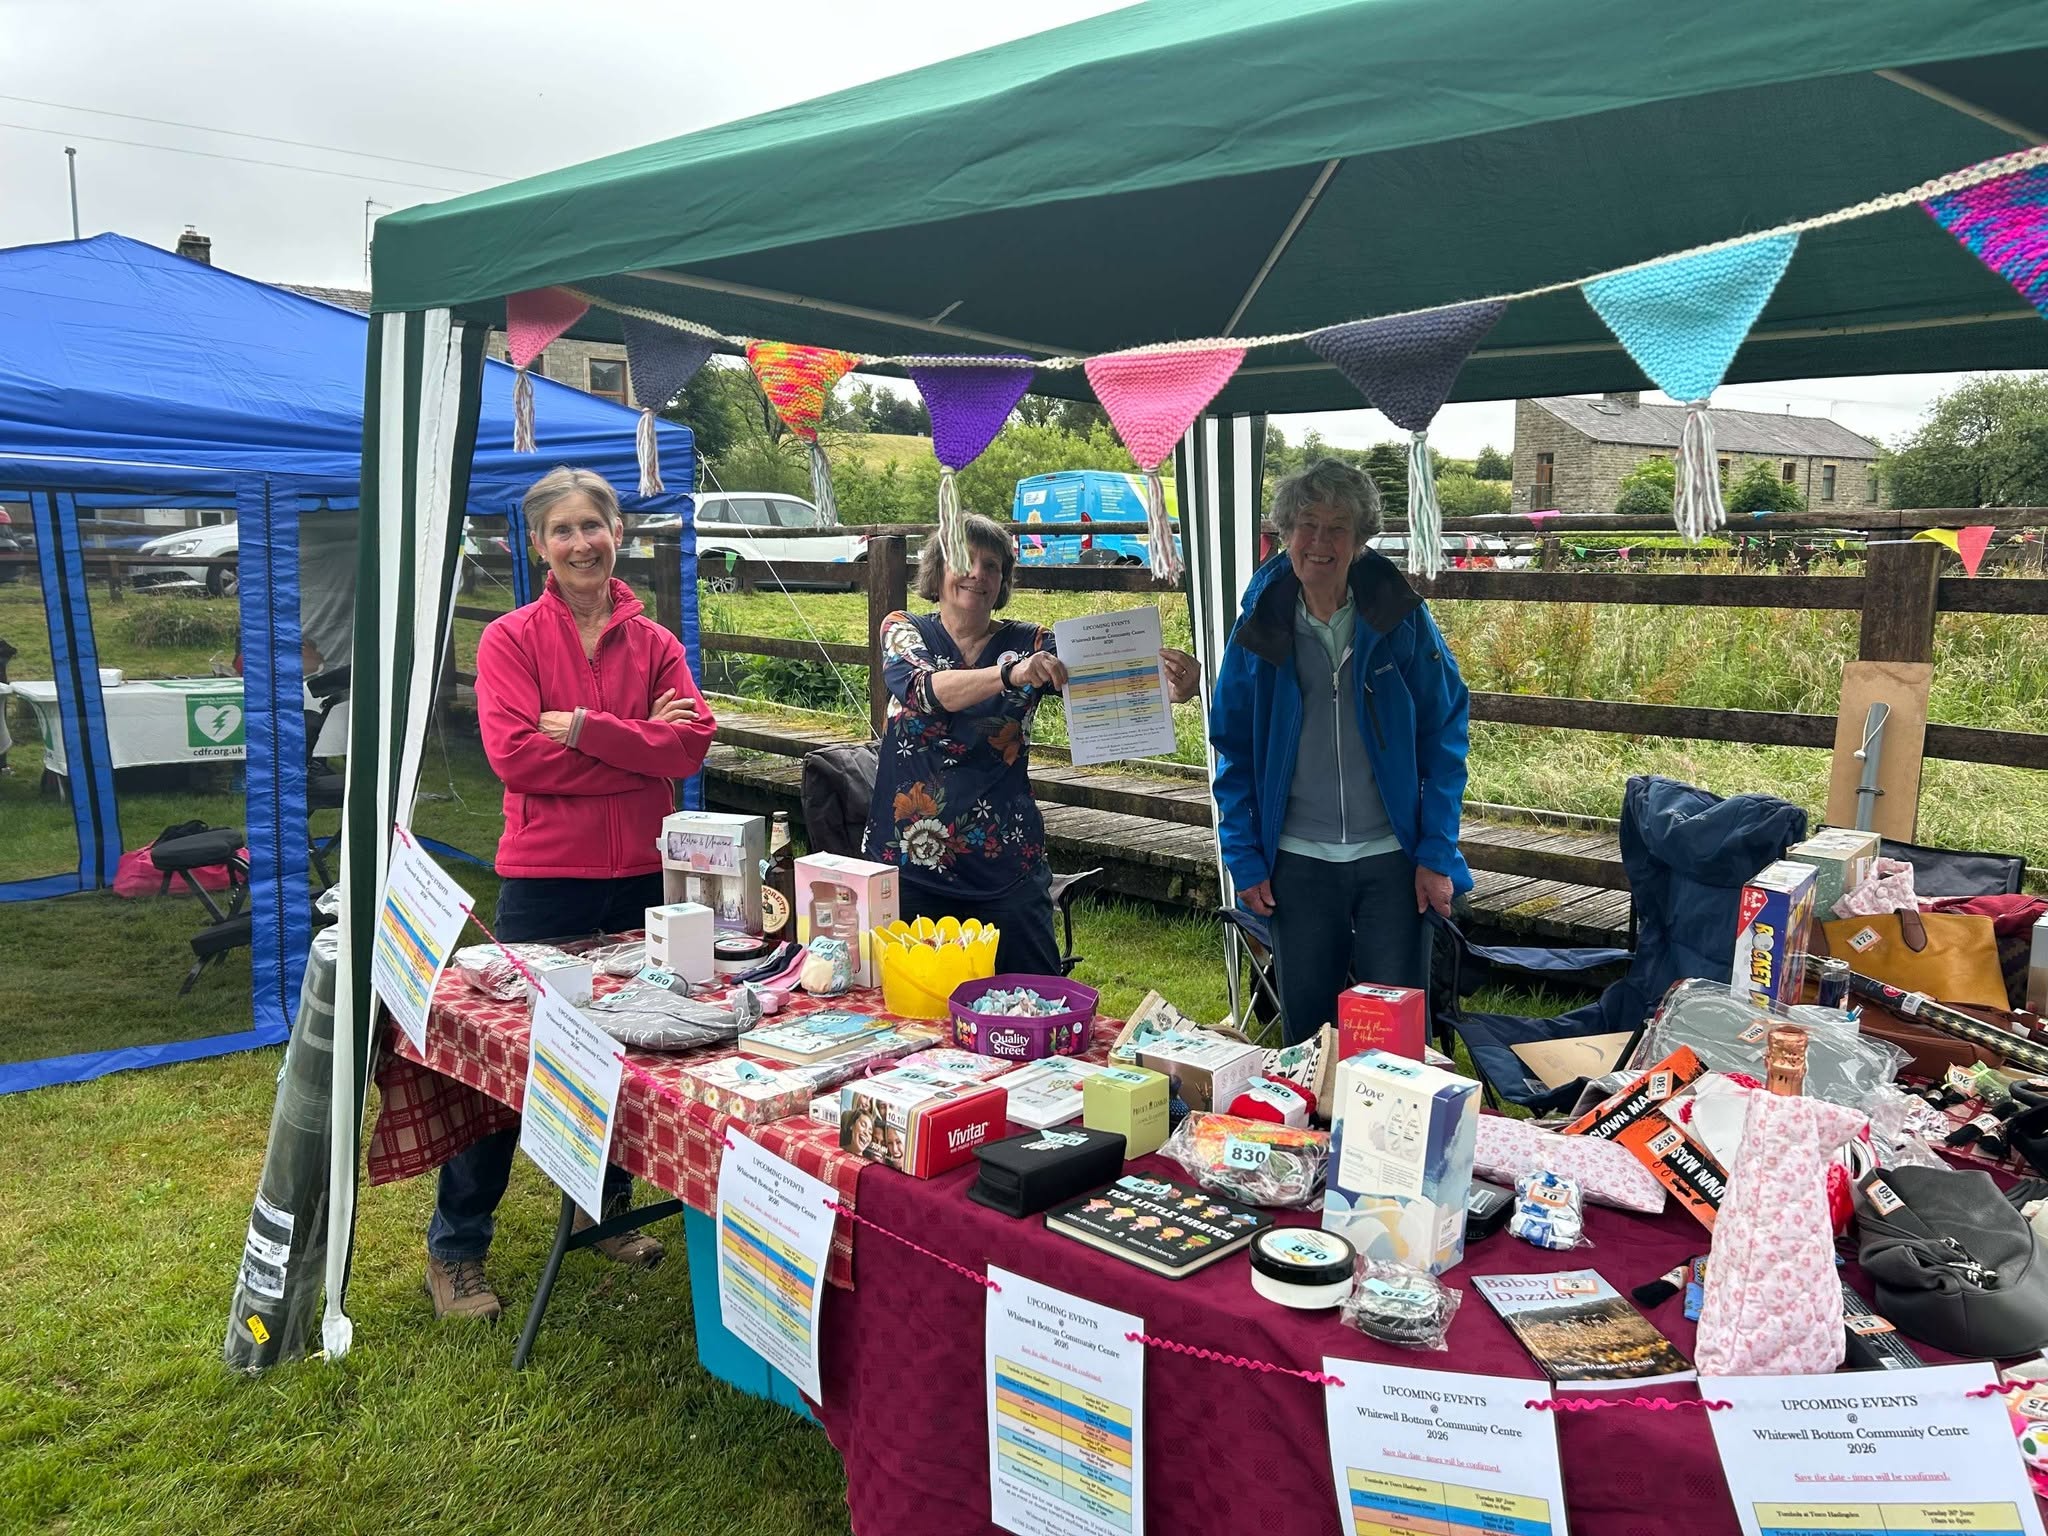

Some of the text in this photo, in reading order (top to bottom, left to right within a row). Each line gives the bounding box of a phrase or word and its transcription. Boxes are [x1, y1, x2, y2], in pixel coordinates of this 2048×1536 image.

[193, 746, 243, 756] cdfr.org.uk
[1855, 933, 1873, 946] 175
[647, 973, 670, 985] 580
[990, 1032, 1030, 1047] Quality
[994, 1043, 1026, 1056] Street
[1376, 1063, 1412, 1076] 875
[1355, 1081, 1385, 1101] Dove
[1656, 1076, 1666, 1095] 130
[1589, 1090, 1652, 1139] CLOWN MA
[948, 1121, 989, 1149] Vivitar
[1654, 1134, 1677, 1152] 230
[1231, 1147, 1266, 1163] 830
[1668, 1145, 1702, 1174] MAS
[752, 1156, 805, 1194] UPCOMING EVENTS
[1542, 1190, 1558, 1201] 10
[1878, 1185, 1897, 1207] 160
[1106, 1188, 1236, 1241] TEN LITTLE PIRATES
[1291, 1245, 1328, 1261] 870
[1484, 1278, 1549, 1290] Bobby
[1495, 1290, 1576, 1302] Dazzler
[1027, 1296, 1098, 1329] UPCOMING EVENTS
[1855, 1320, 1875, 1328] 15
[1007, 1309, 1120, 1359] Whitewell Bottom Community Centre
[1383, 1385, 1487, 1407] UPCOMING EVENTS
[1781, 1395, 1918, 1411] UPCOMING EVENTS
[1430, 1404, 1439, 1414] @
[1356, 1406, 1523, 1438] Whitewell Bottom Community Centre
[1847, 1413, 1858, 1424] @
[1426, 1429, 1449, 1441] 2026
[1752, 1425, 1970, 1440] Whitewell Bottom Community Centre
[1847, 1443, 1877, 1454] 2026
[1794, 1473, 1811, 1482] Save
[1814, 1473, 1826, 1482] the
[1828, 1473, 1844, 1481] date
[1875, 1472, 1890, 1481] will
[1892, 1473, 1902, 1481] be
[1904, 1472, 1951, 1482] confirmed.
